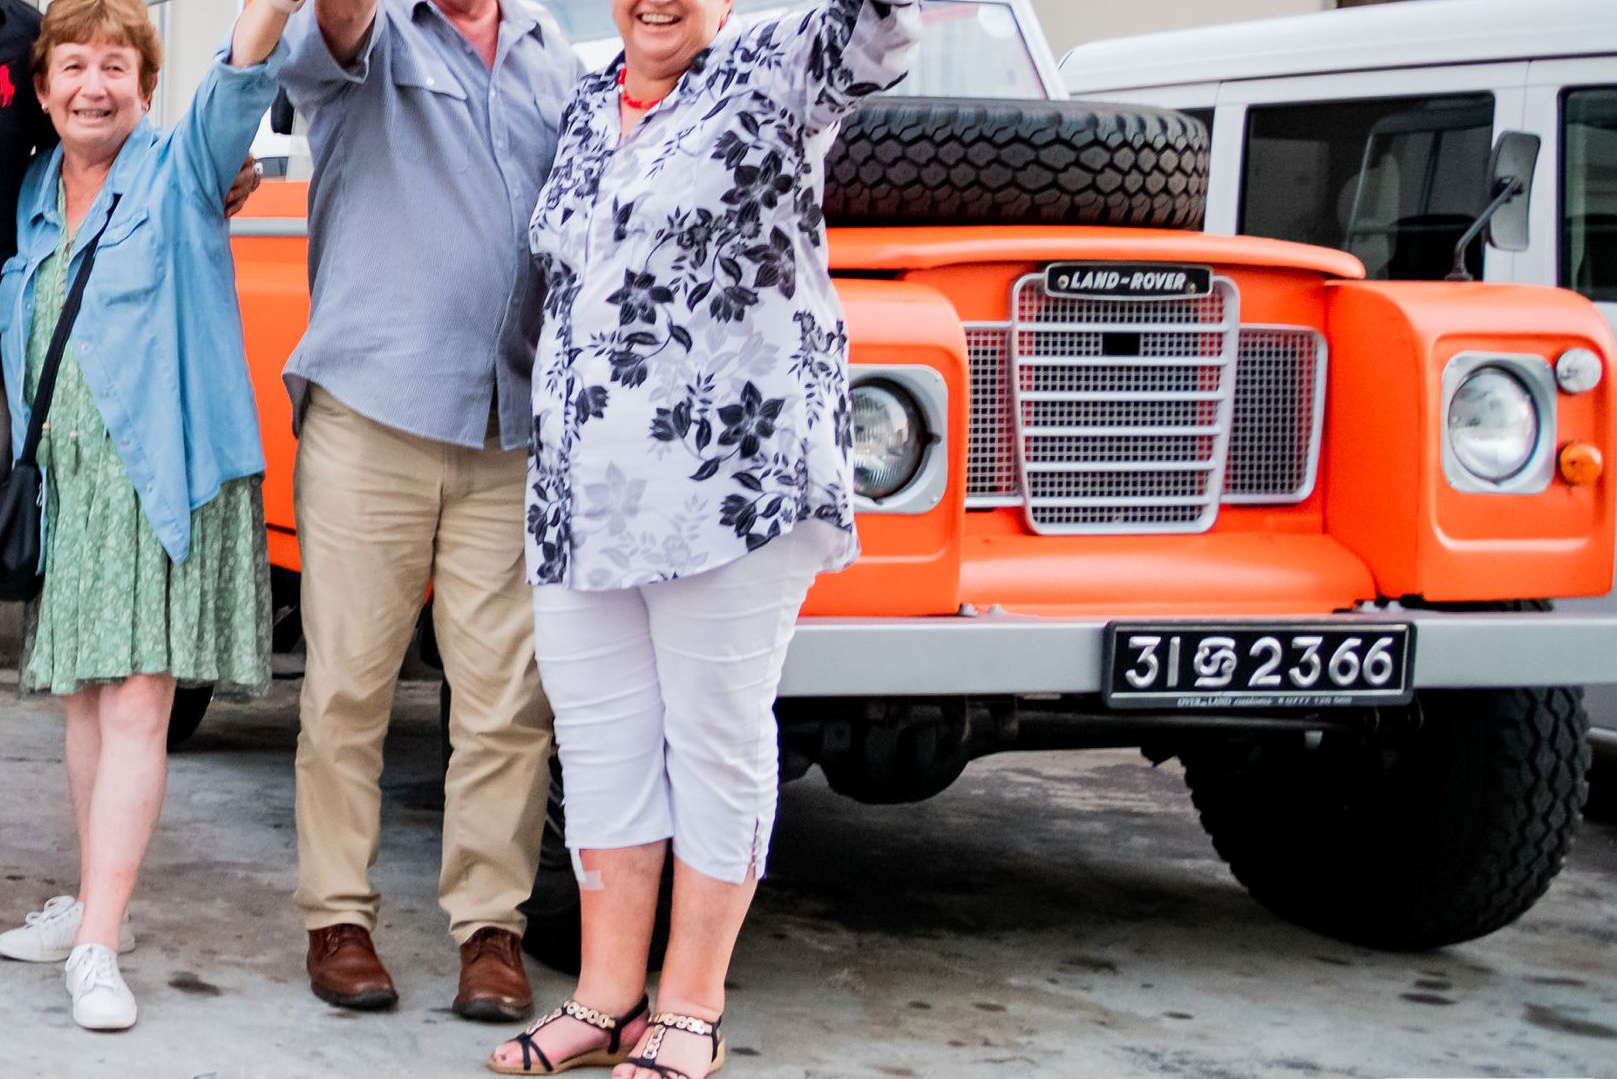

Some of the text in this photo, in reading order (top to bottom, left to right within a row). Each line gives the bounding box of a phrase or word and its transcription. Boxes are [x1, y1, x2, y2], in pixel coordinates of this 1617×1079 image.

[1070, 271, 1186, 290] LAND-ROVER
[1124, 635, 1182, 688] 31
[1247, 636, 1394, 688] 2366
